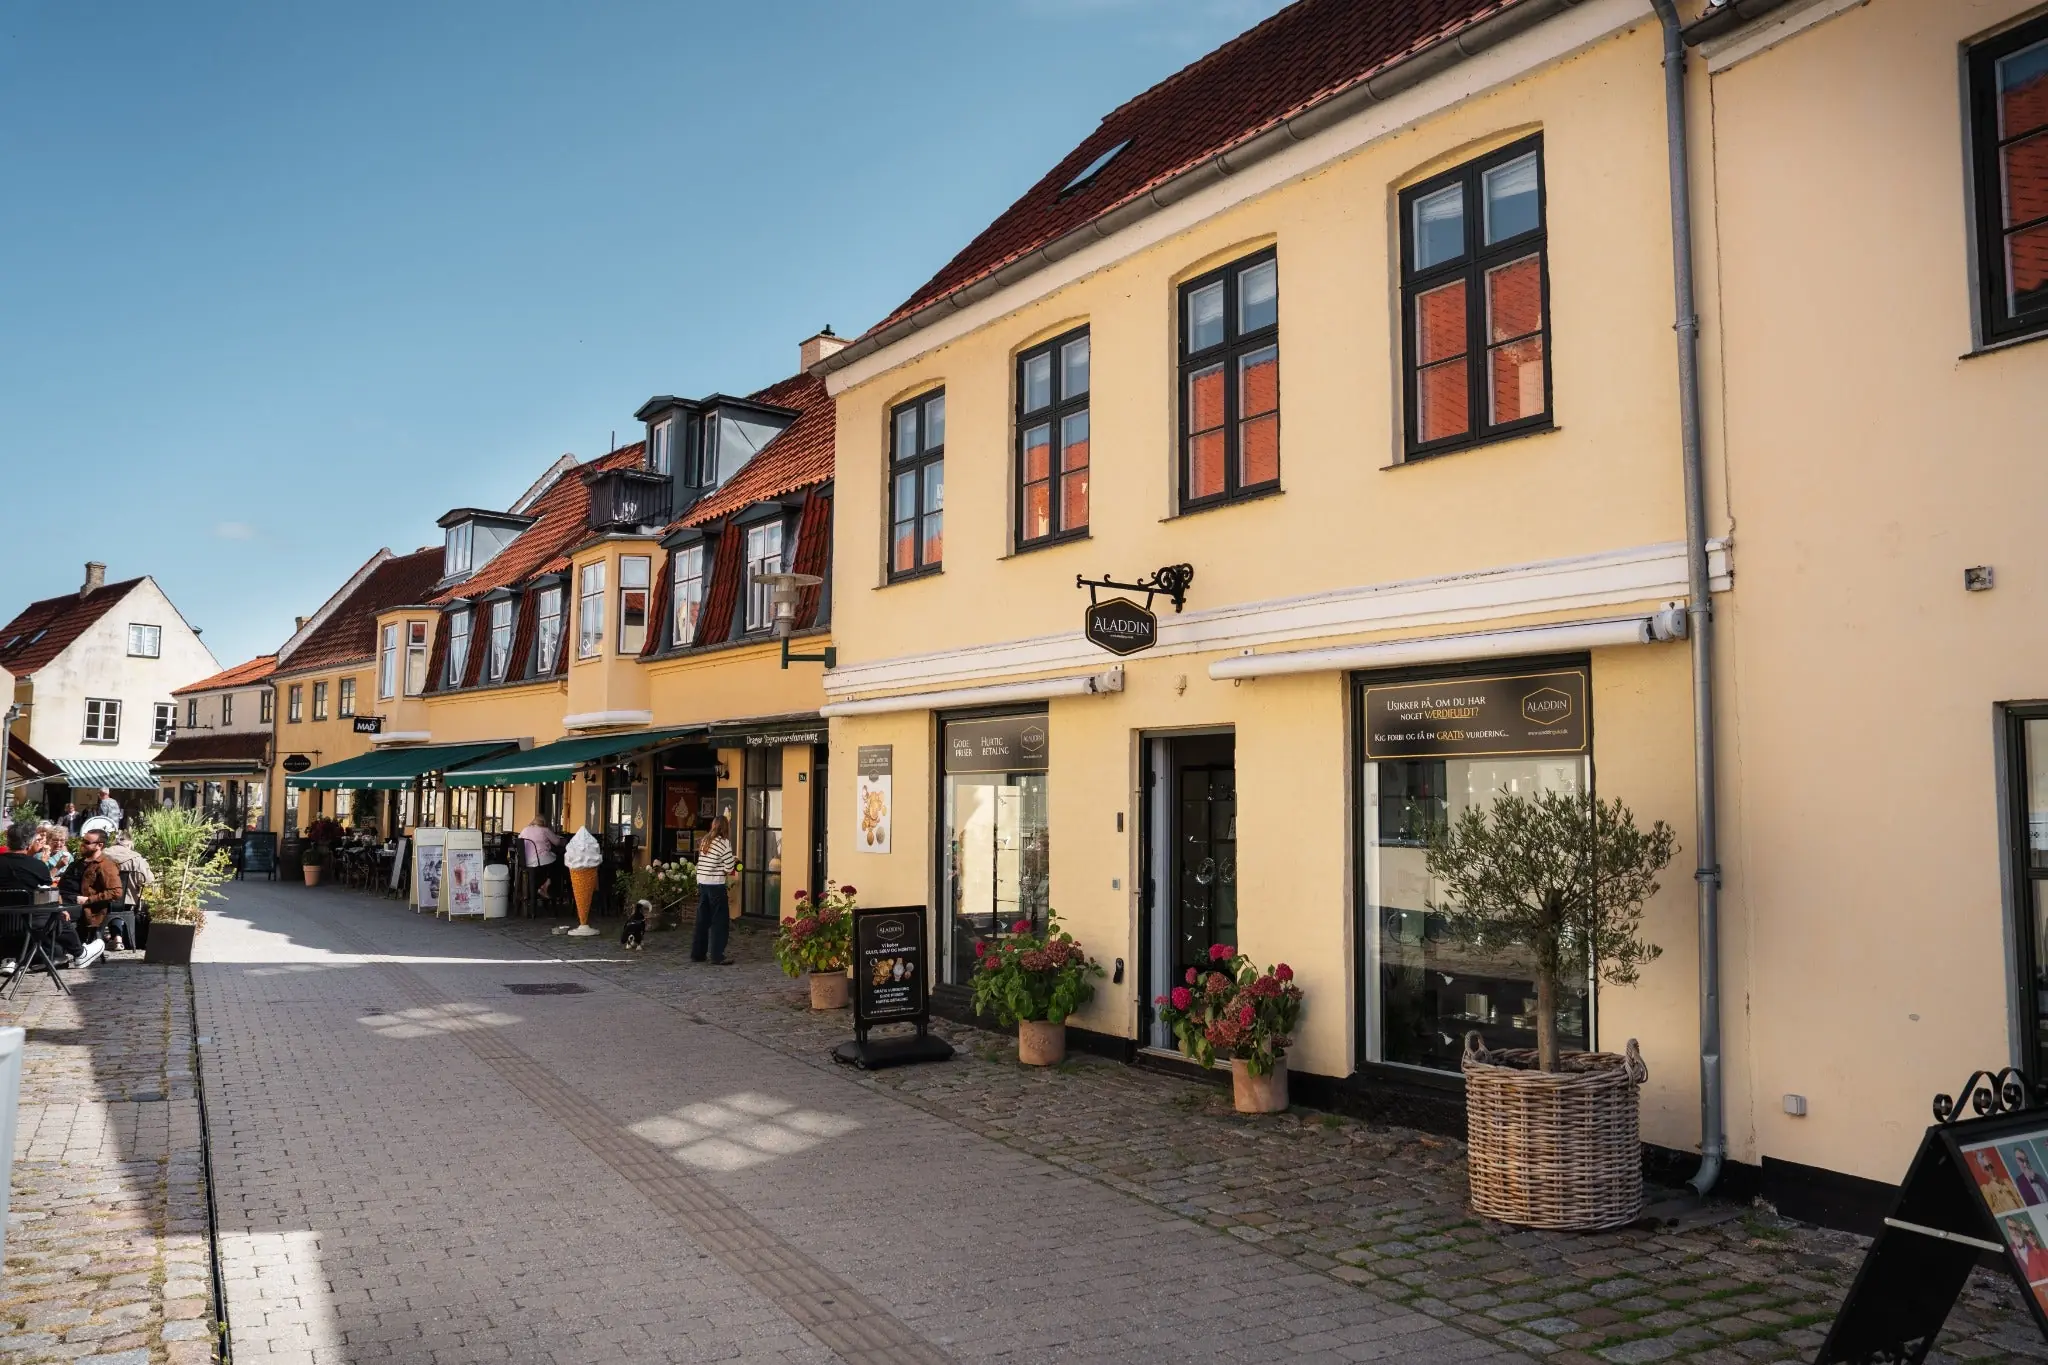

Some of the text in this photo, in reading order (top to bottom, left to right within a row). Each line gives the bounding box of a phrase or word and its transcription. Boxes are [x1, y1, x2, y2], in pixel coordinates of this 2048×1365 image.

[1094, 616, 1150, 633] ALADDIN
[1387, 700, 1419, 711] USIKKER
[1435, 699, 1450, 708] OM
[1453, 698, 1465, 707] DU
[1468, 696, 1486, 705] HAR
[1527, 700, 1567, 712] ALADDIN
[1400, 707, 1479, 721] NOGET VÆRDIFULDT?
[357, 722, 375, 731] MAD
[1374, 733, 1386, 742] KIG
[1406, 733, 1416, 741] OG
[1426, 732, 1435, 740] EN
[1437, 730, 1464, 740] GRATIS
[953, 738, 970, 748] GODE
[955, 748, 973, 757] PRISER
[982, 747, 1010, 756] BETALING
